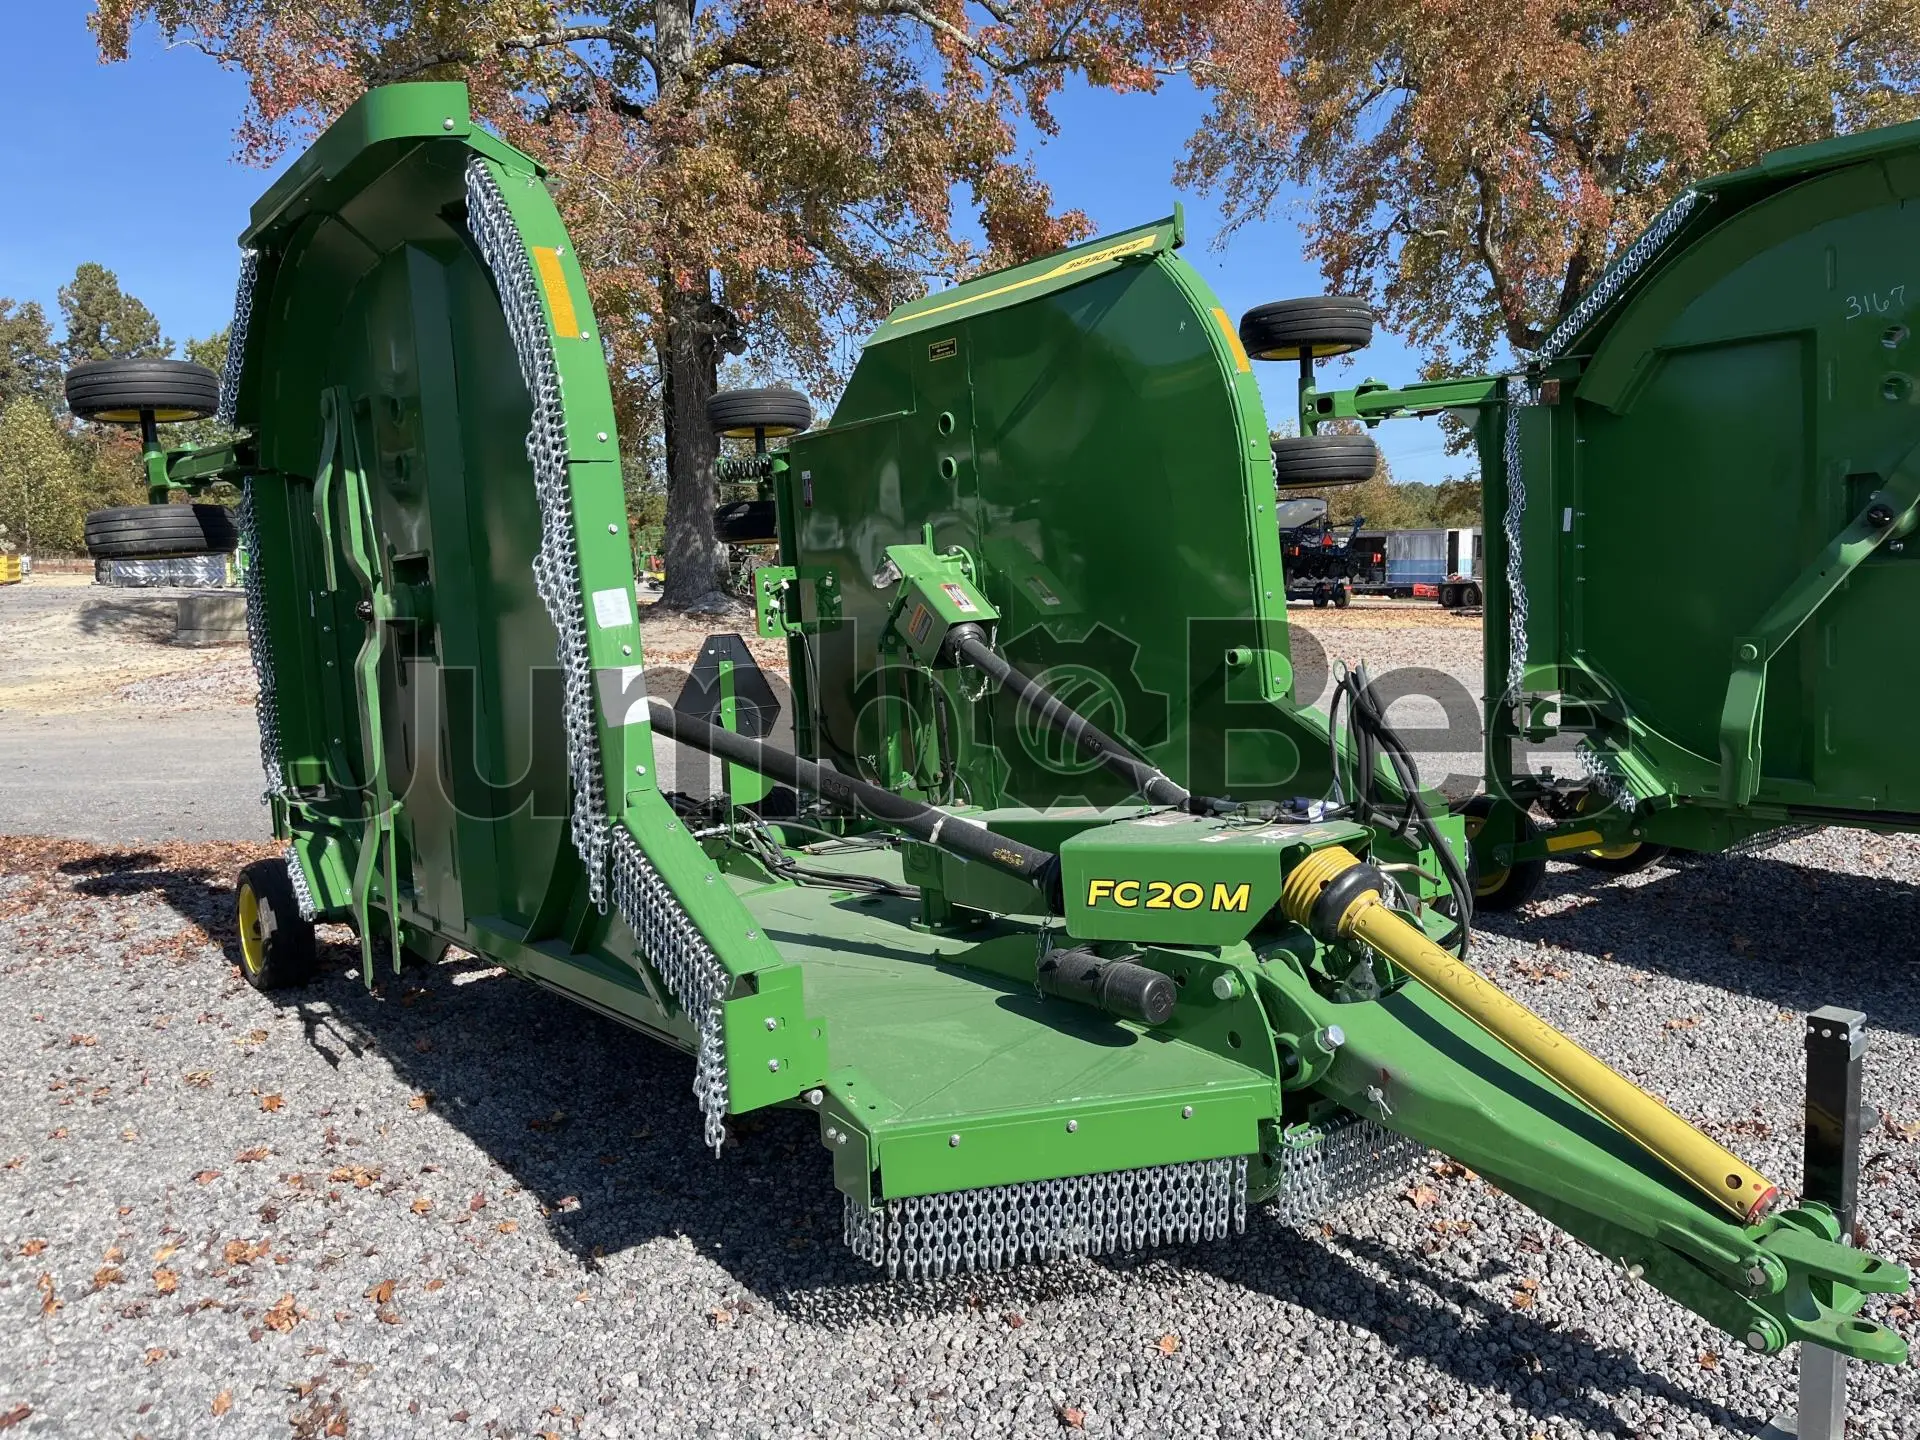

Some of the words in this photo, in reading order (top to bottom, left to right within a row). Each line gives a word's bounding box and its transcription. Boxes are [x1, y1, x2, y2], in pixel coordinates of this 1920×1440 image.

[1107, 240, 1145, 257] JOHN
[1066, 253, 1107, 270] DEERE
[1845, 284, 1905, 320] 3167
